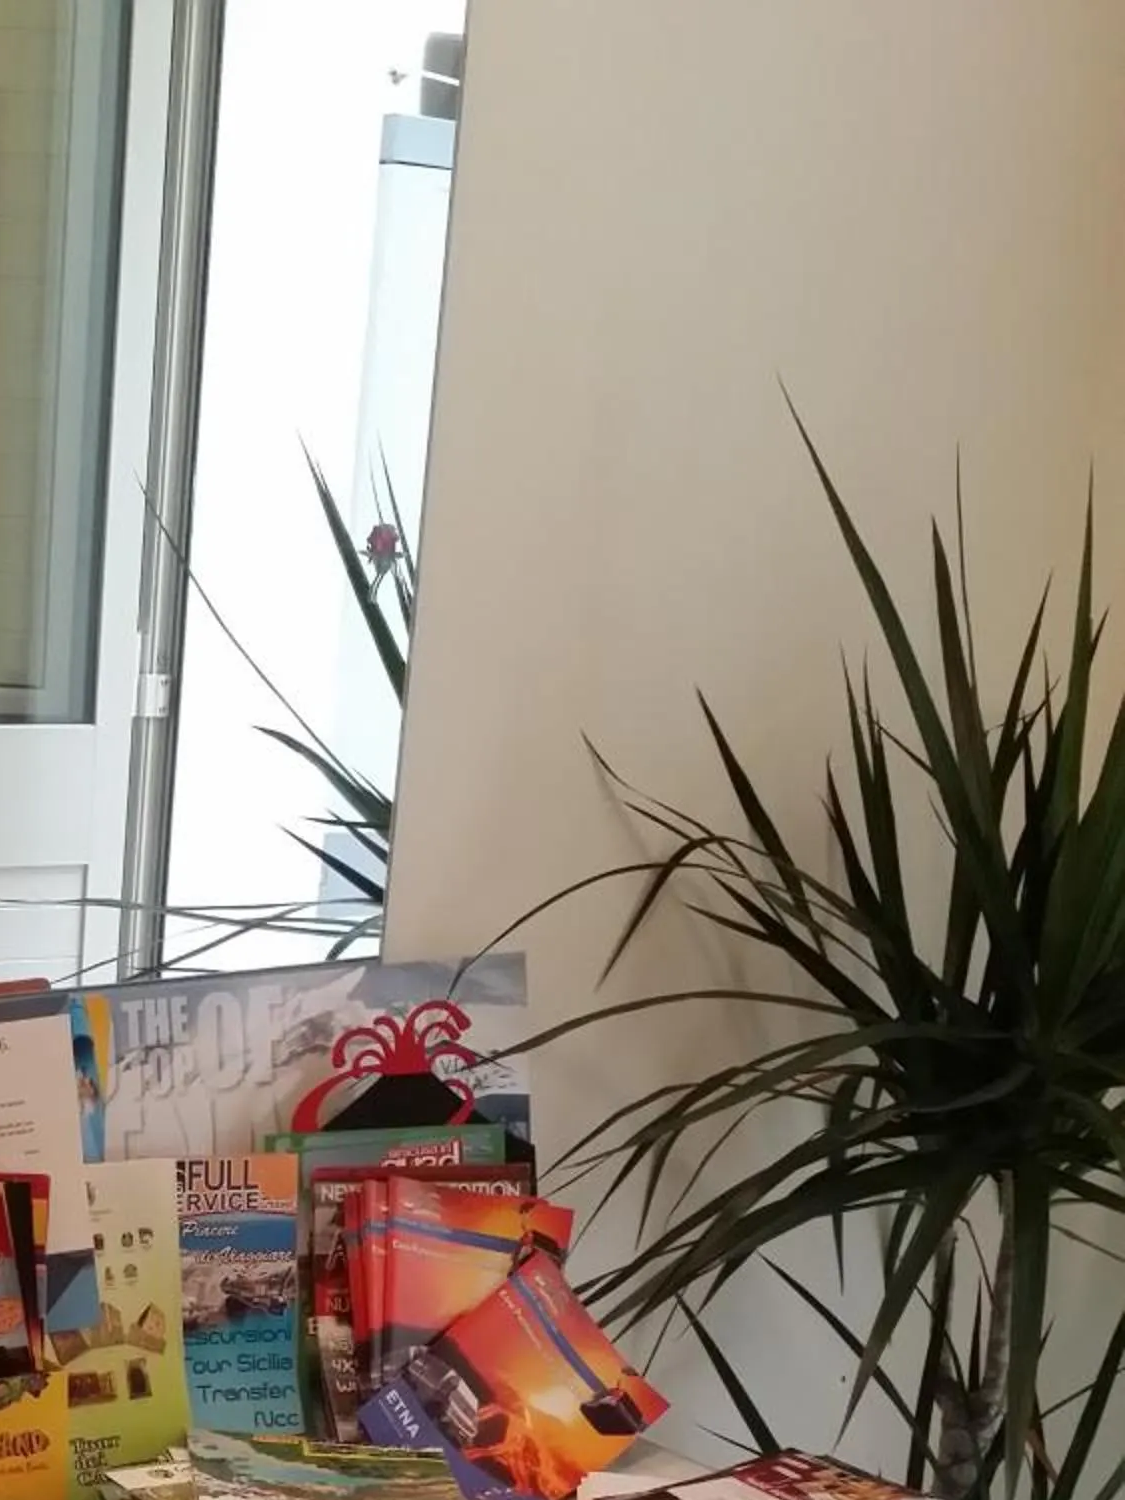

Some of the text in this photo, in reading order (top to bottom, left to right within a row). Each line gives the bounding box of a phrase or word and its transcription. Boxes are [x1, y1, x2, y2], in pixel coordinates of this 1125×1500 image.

[122, 985, 282, 1090] THE OF
[188, 1159, 259, 1191] FULL
[236, 1352, 294, 1373] Sicilia
[194, 1382, 296, 1405] Transfer
[385, 1388, 420, 1439] ETNA
